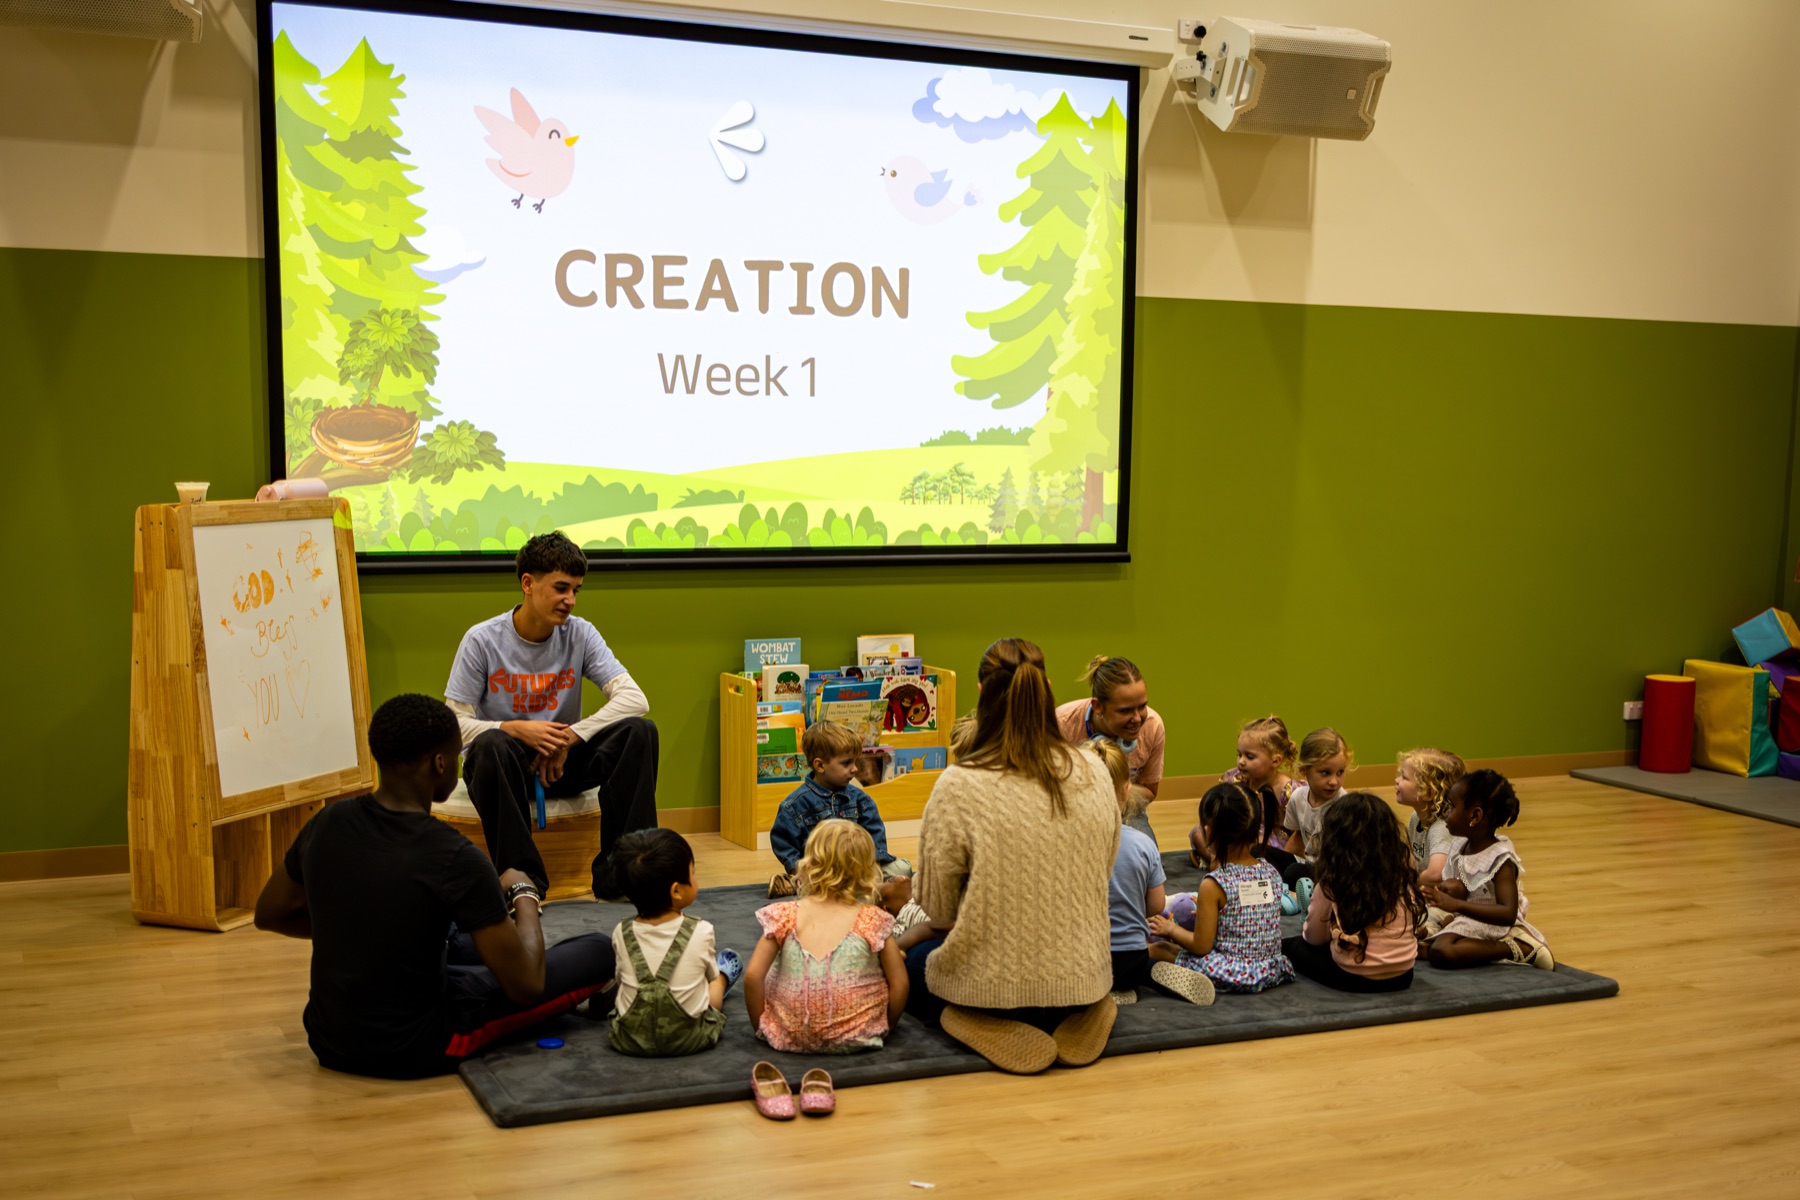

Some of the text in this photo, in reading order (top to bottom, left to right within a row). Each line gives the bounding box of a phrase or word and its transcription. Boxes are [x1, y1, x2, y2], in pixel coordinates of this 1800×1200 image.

[554, 248, 910, 319] CREATION
[656, 352, 816, 398] Week 1
[751, 641, 796, 654] WOMBAT
[759, 653, 789, 665] STEW
[488, 667, 576, 695] FUTURES
[247, 673, 280, 729] YOU
[512, 690, 559, 713] KIDS
